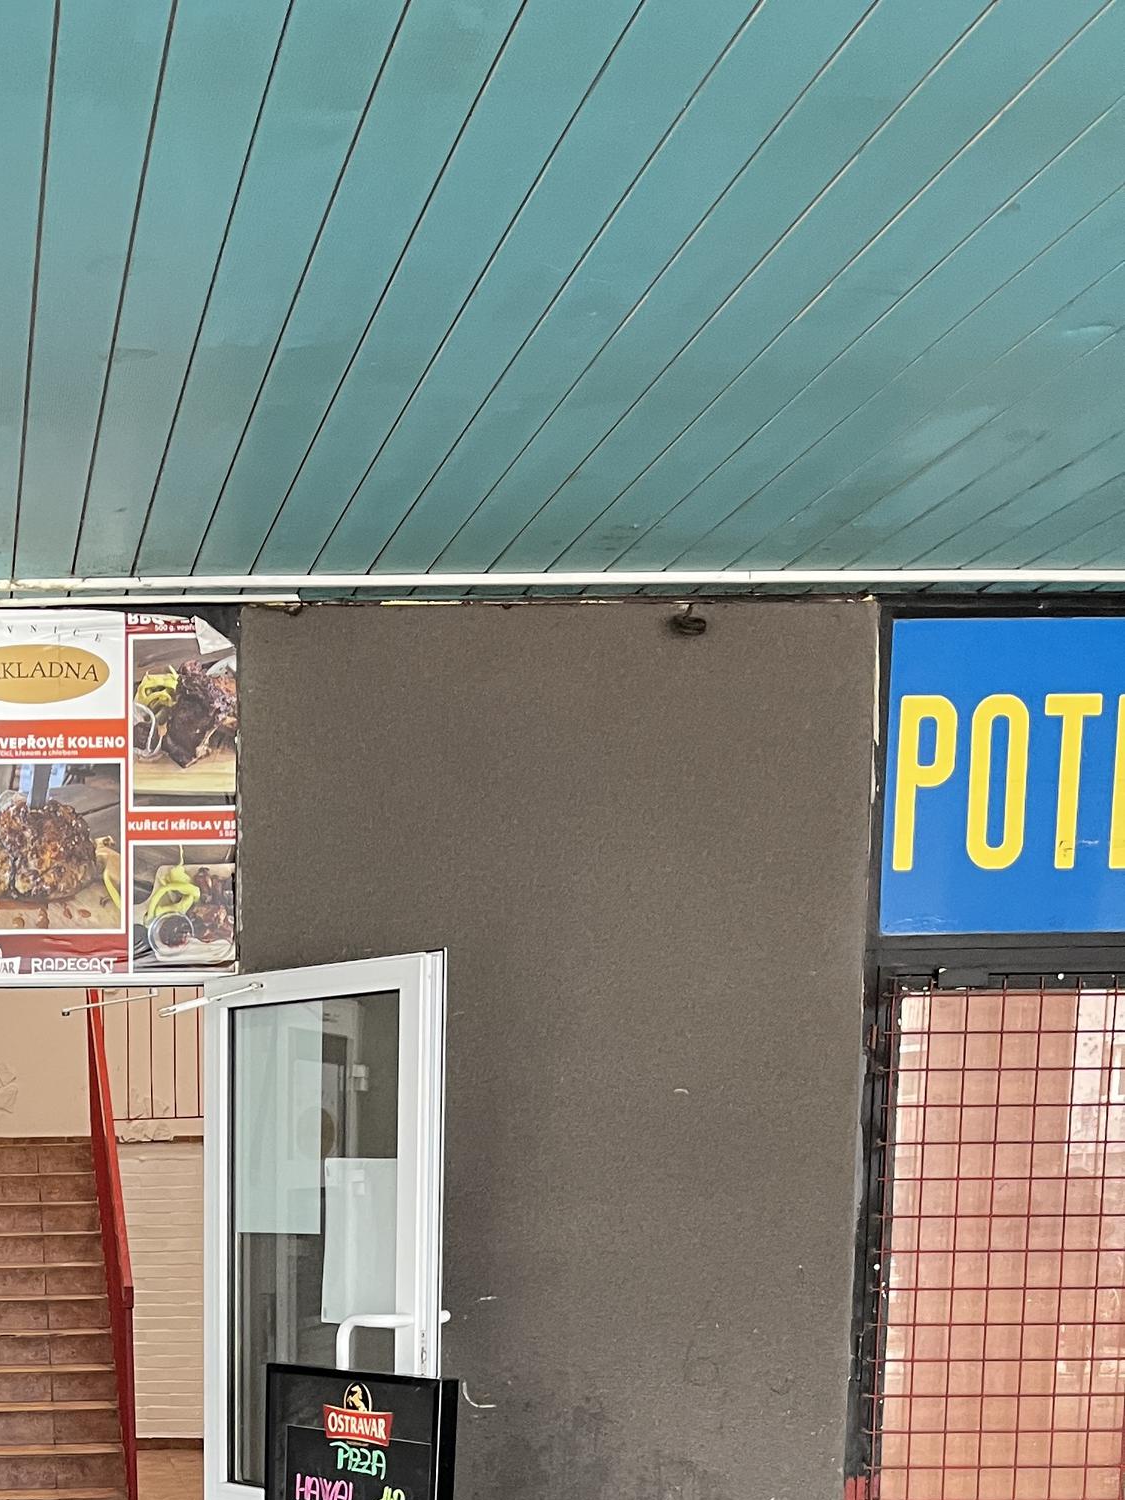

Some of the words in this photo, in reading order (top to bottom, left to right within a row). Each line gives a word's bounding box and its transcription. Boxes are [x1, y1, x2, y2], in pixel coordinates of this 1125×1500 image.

[0, 733, 65, 749] VEPŘOVÉ
[68, 736, 126, 749] KOLENO
[128, 818, 169, 831] KUŘECÍ
[171, 818, 212, 831] KŘÍDLA
[213, 820, 222, 830] V
[31, 958, 118, 974] RADEGAST
[328, 1412, 386, 1440] OSTRAVAR
